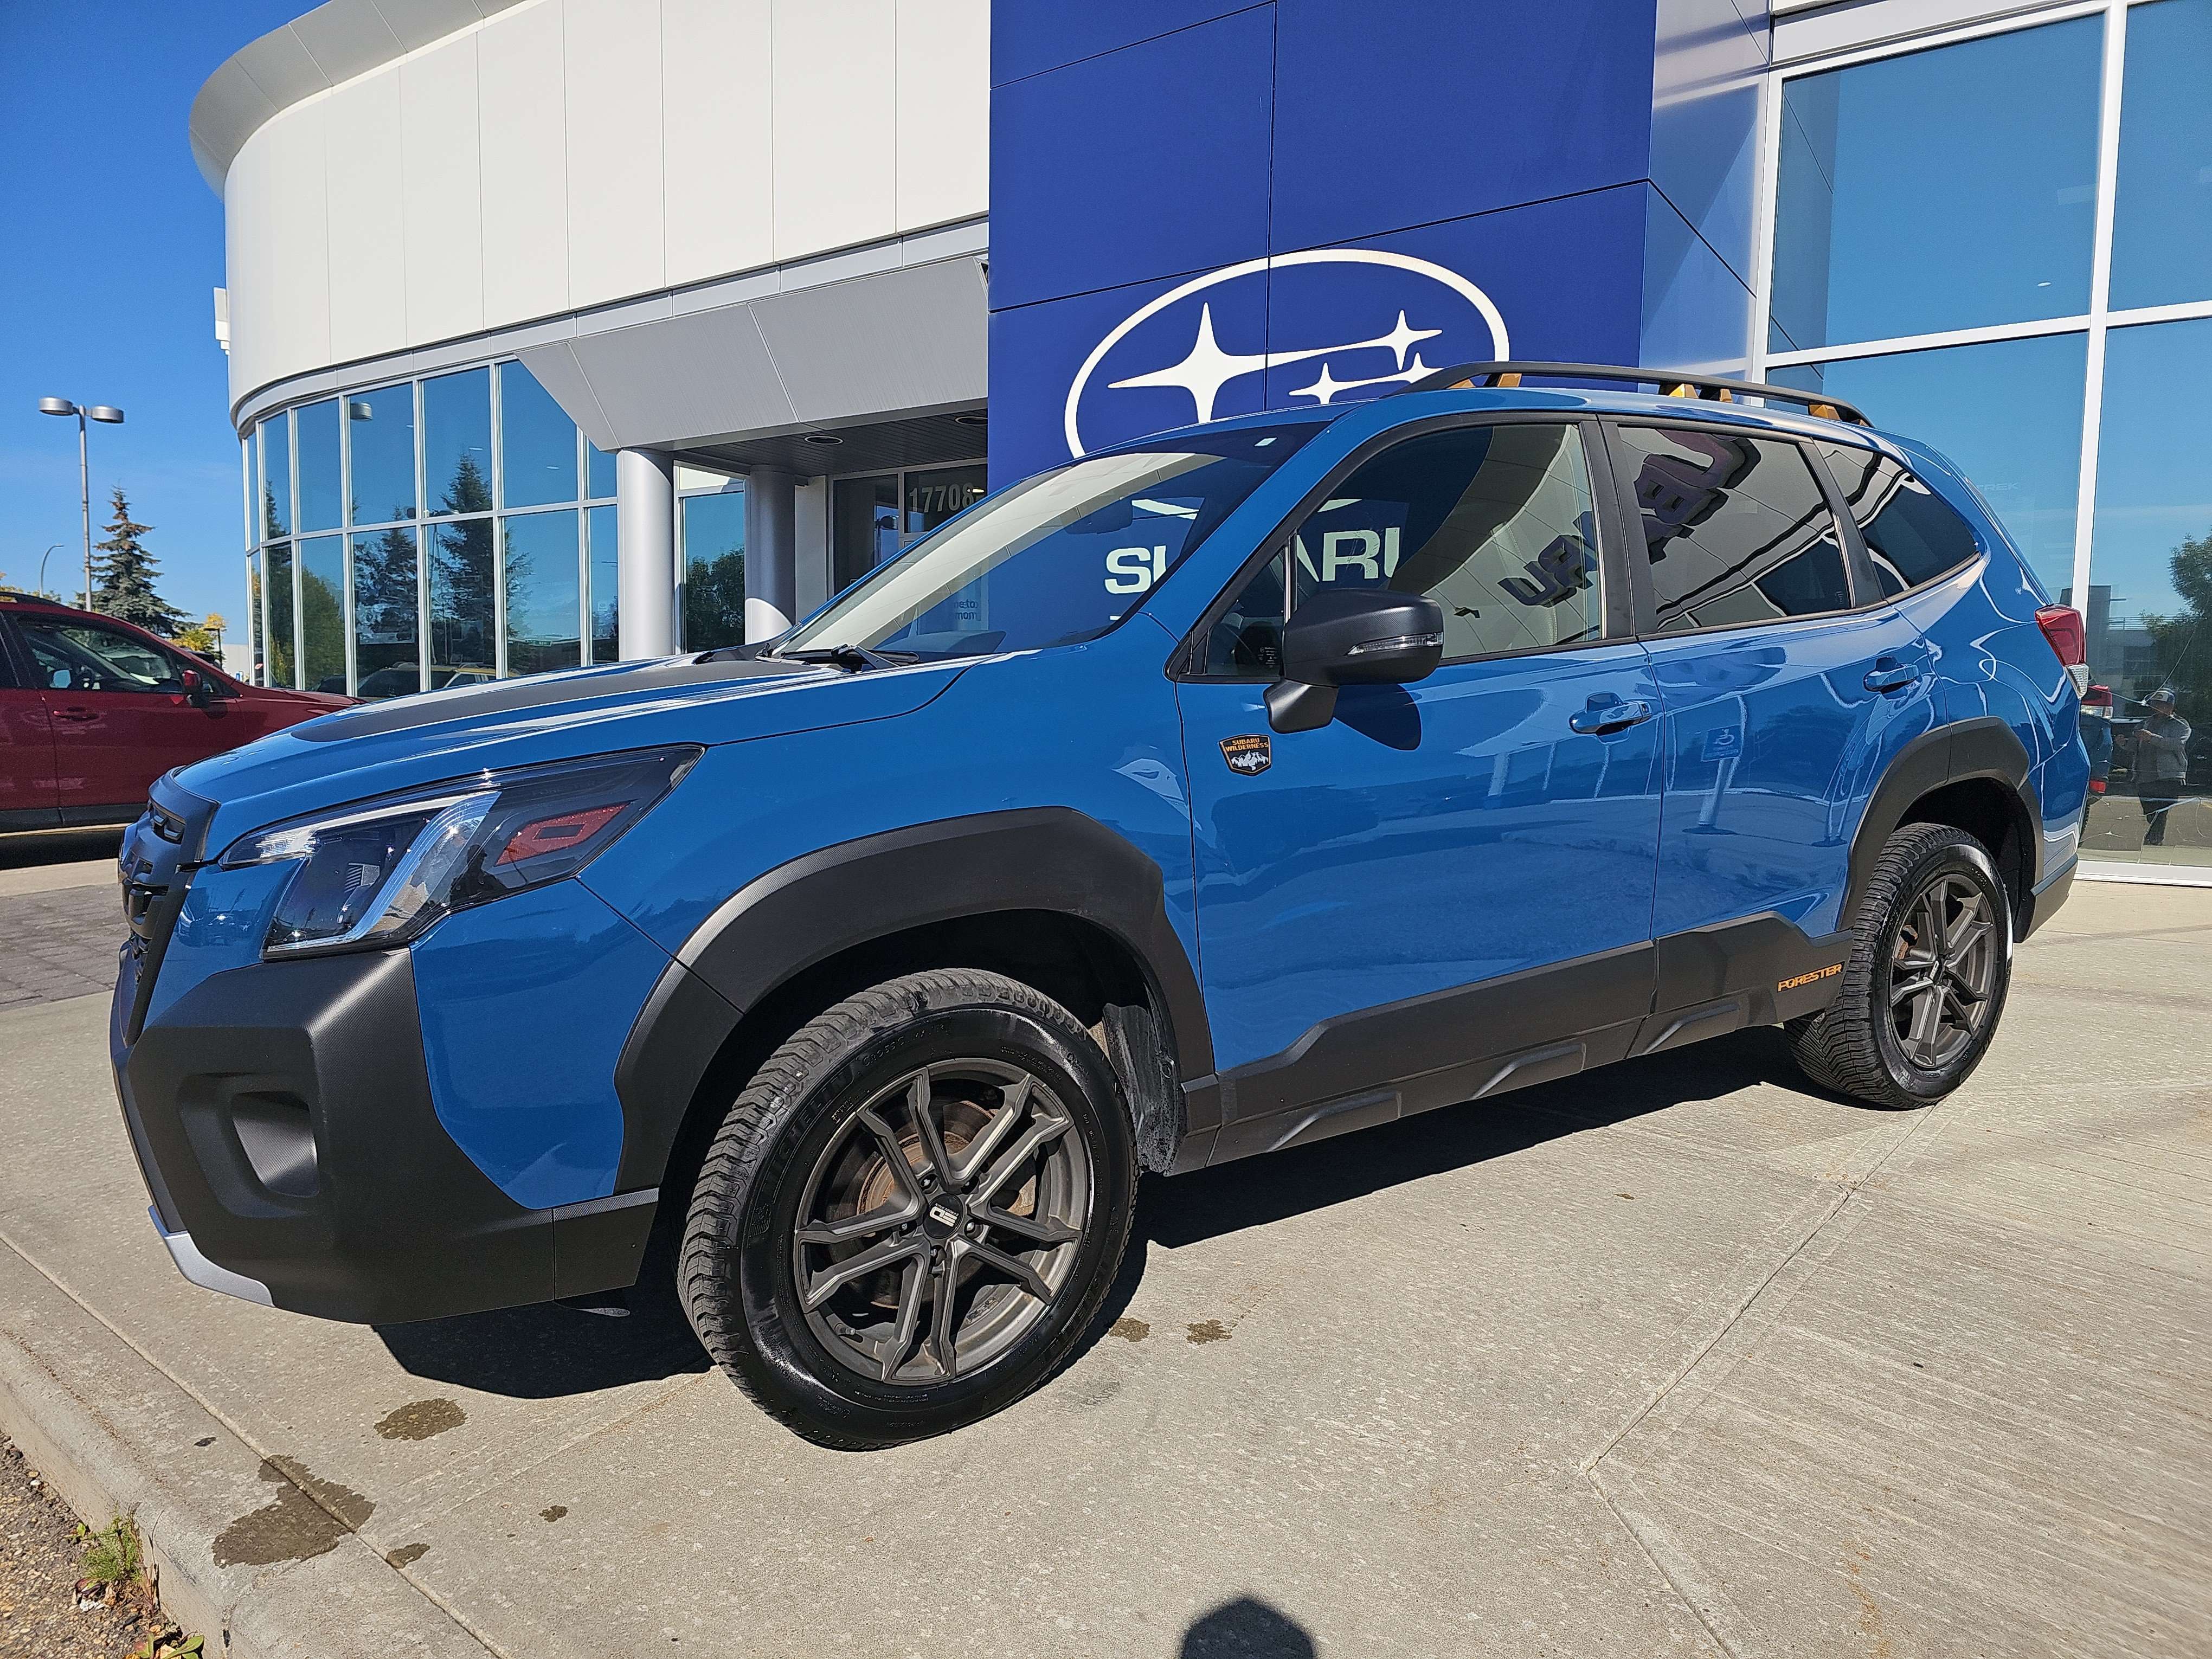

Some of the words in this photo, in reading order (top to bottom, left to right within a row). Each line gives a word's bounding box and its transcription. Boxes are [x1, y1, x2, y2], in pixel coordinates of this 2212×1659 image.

[909, 482, 974, 513] 17708
[1225, 742, 1269, 752] WILDERNESS
[1232, 737, 1260, 745] SUBARU
[1778, 963, 1842, 992] FORESTER
